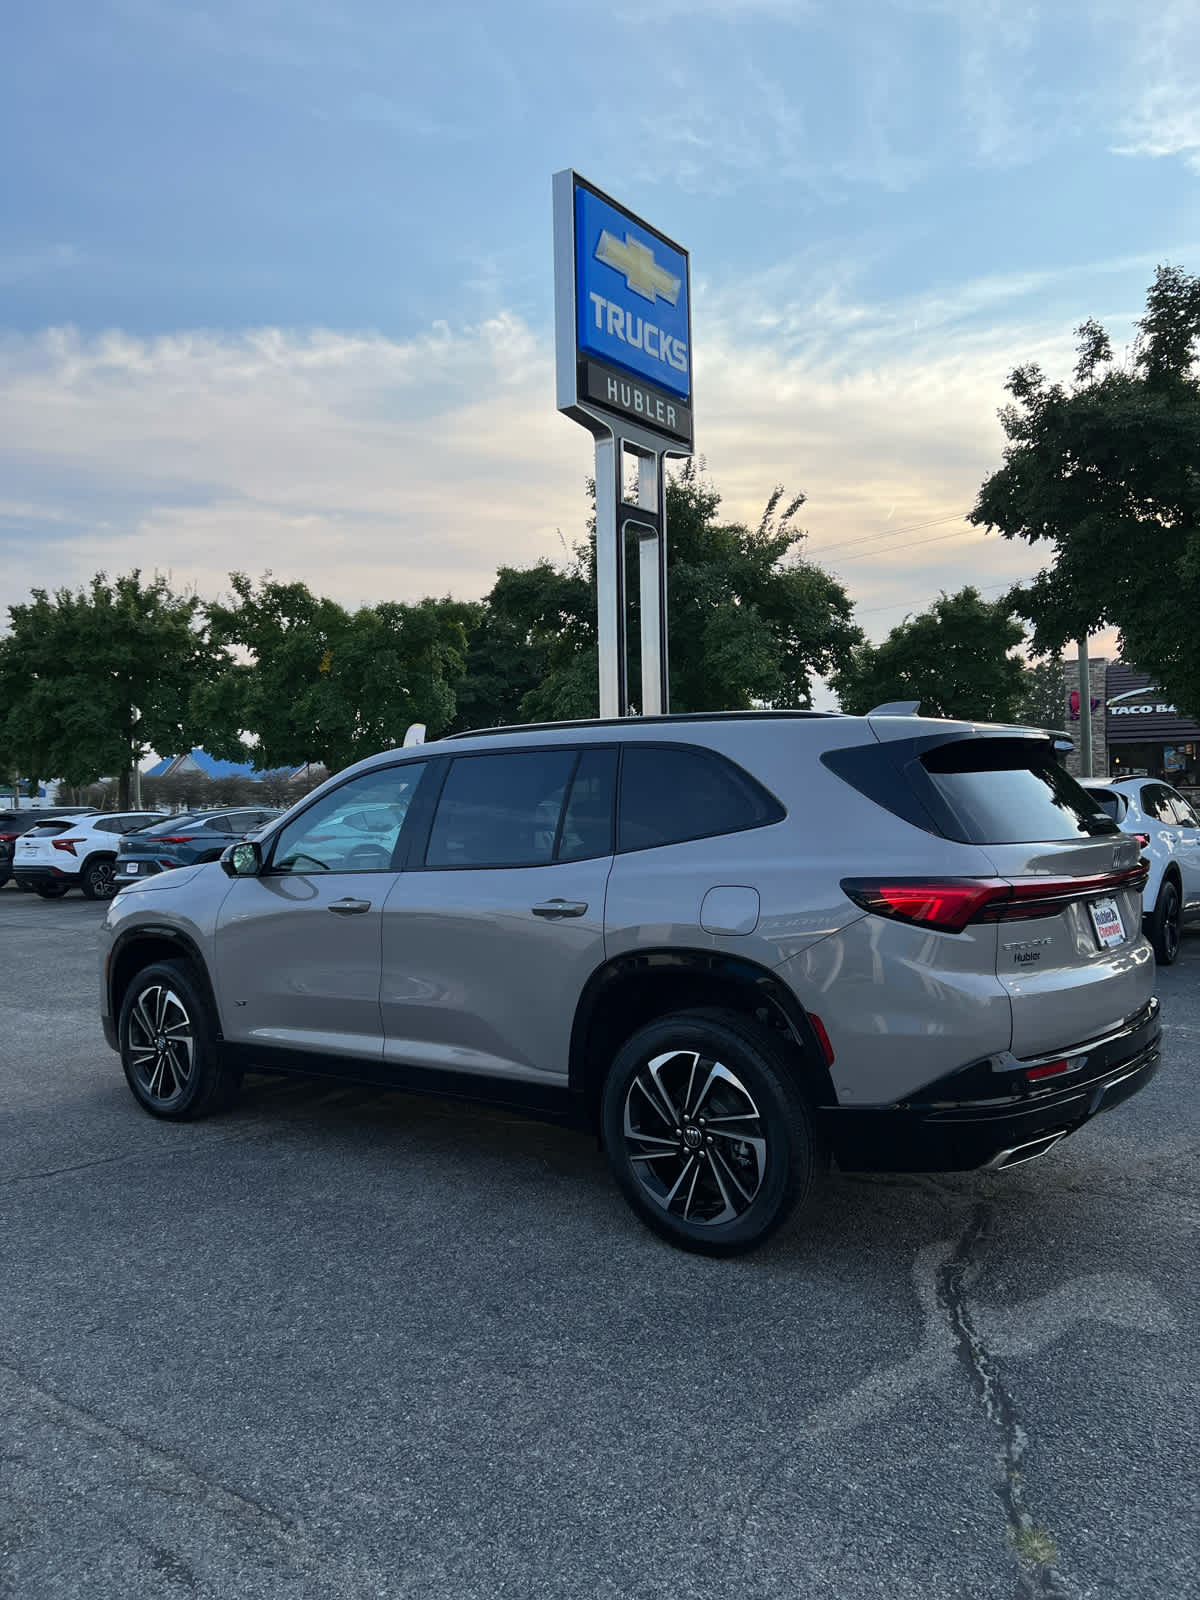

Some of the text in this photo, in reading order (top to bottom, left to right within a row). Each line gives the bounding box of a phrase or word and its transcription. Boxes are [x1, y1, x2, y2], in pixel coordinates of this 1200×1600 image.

[589, 291, 688, 373] TRUCKS
[606, 376, 678, 428] HUBLER
[1109, 705, 1153, 715] TACO
[1014, 952, 1041, 963] Hubler
